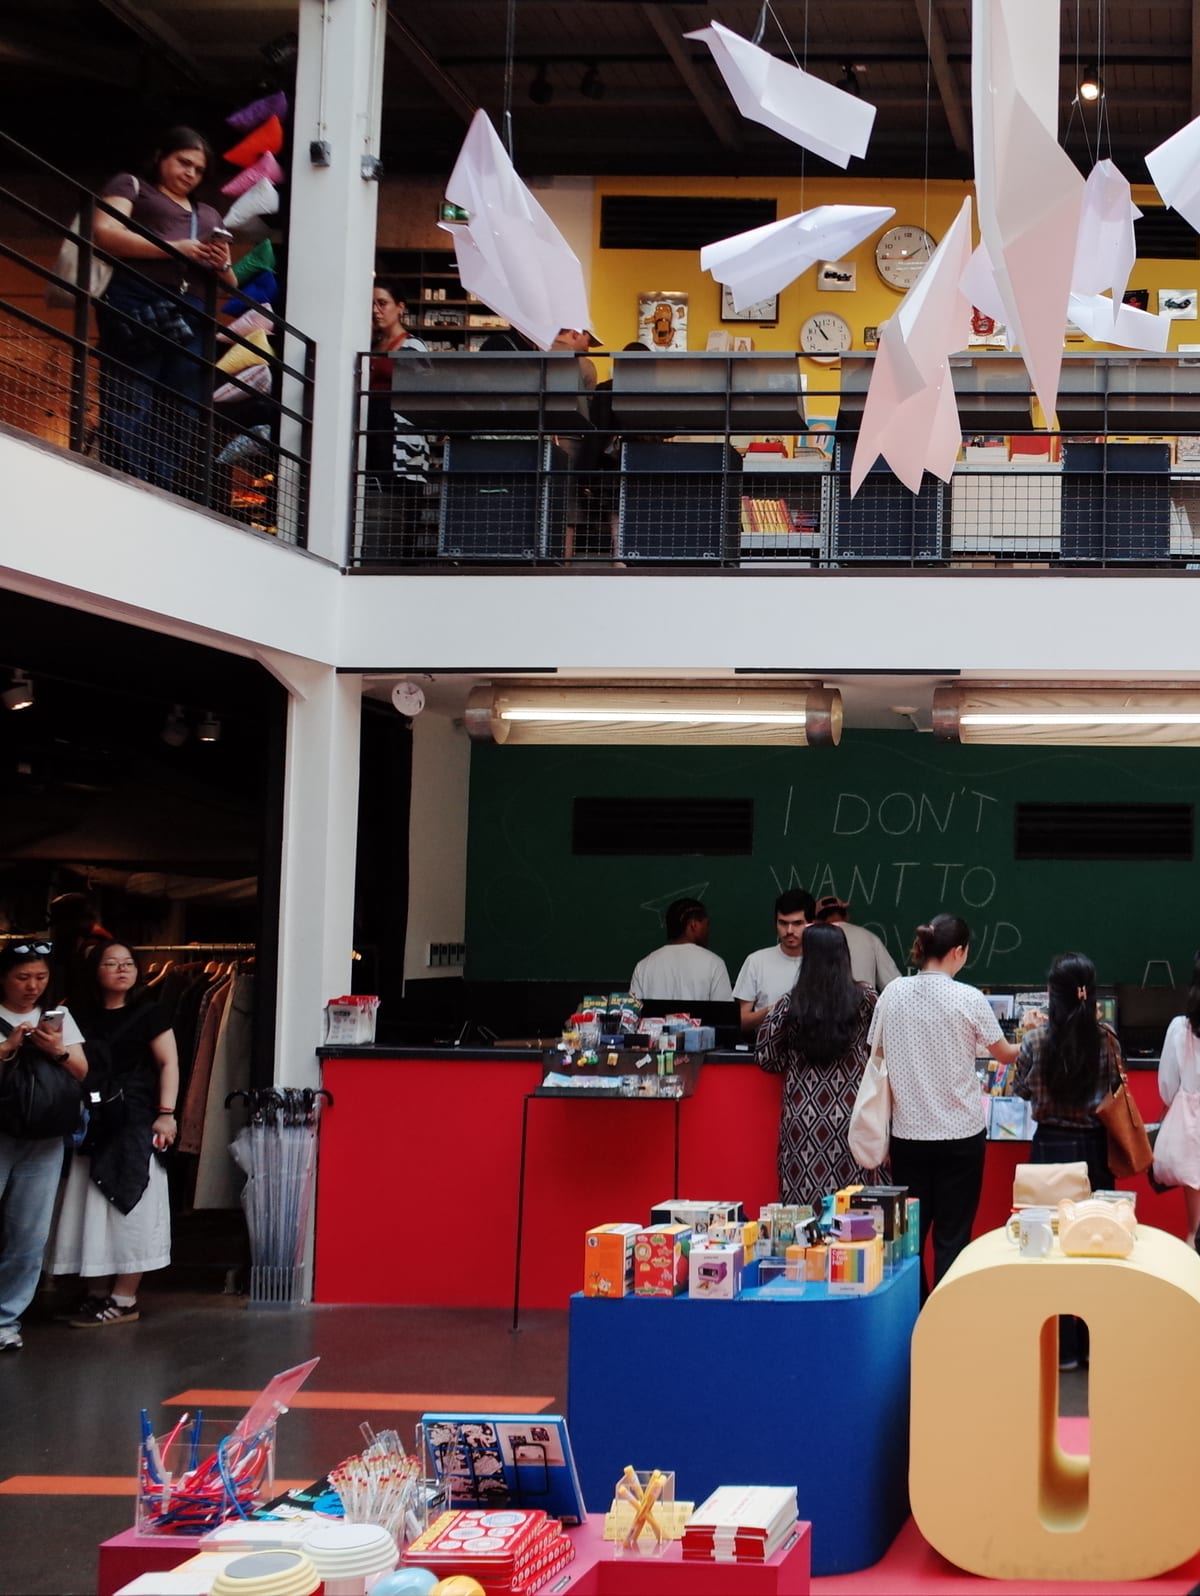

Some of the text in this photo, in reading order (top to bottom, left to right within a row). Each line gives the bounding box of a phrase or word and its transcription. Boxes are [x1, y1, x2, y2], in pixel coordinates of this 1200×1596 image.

[783, 785, 999, 836] I DON'T
[769, 862, 997, 908] WANT TO
